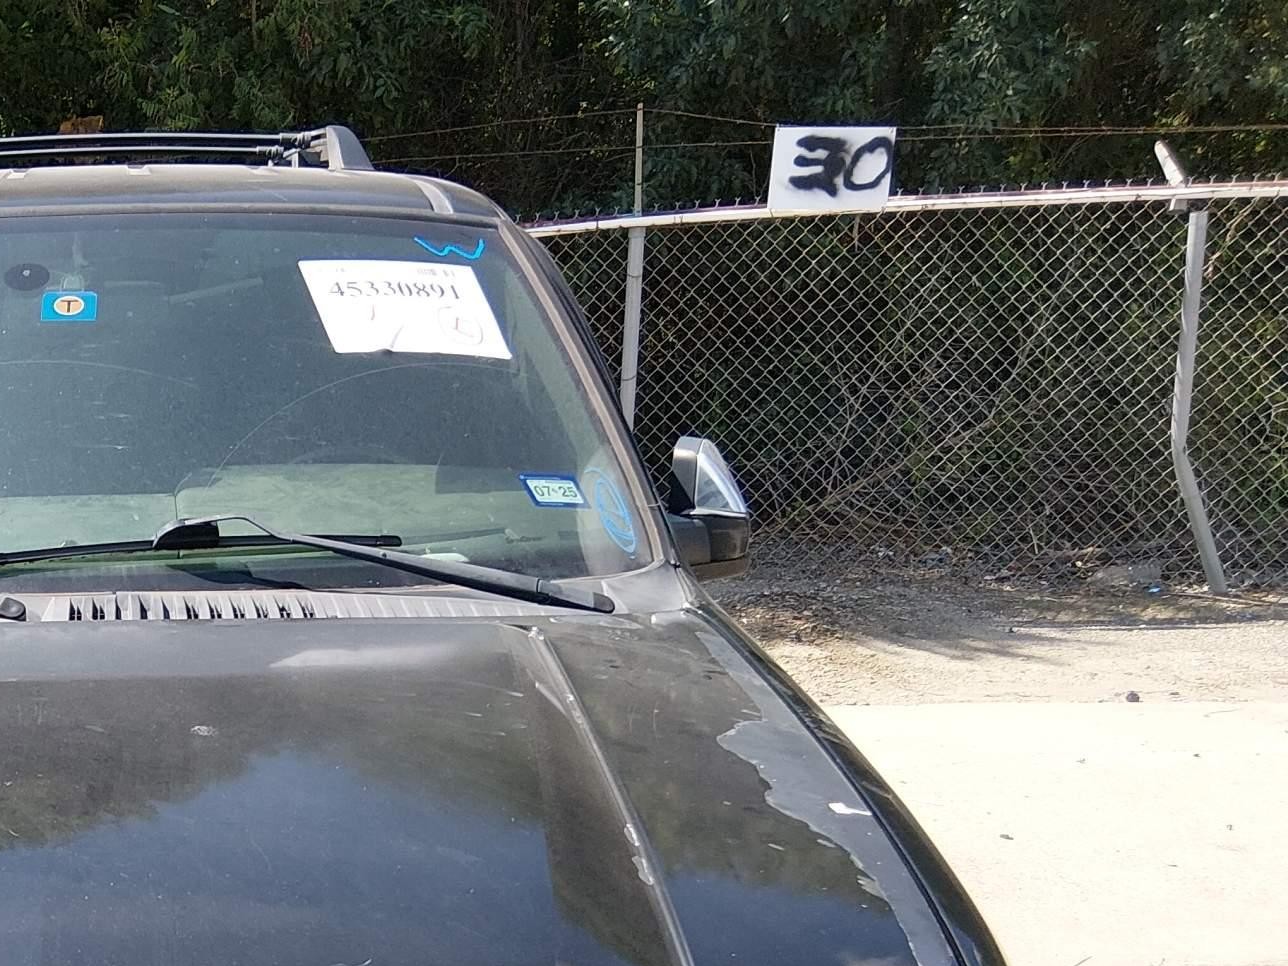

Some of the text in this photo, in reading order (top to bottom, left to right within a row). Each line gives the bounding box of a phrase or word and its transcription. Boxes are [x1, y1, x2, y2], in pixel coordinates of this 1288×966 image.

[788, 135, 894, 198] 30
[328, 280, 462, 300] 45330891
[59, 299, 80, 313] T
